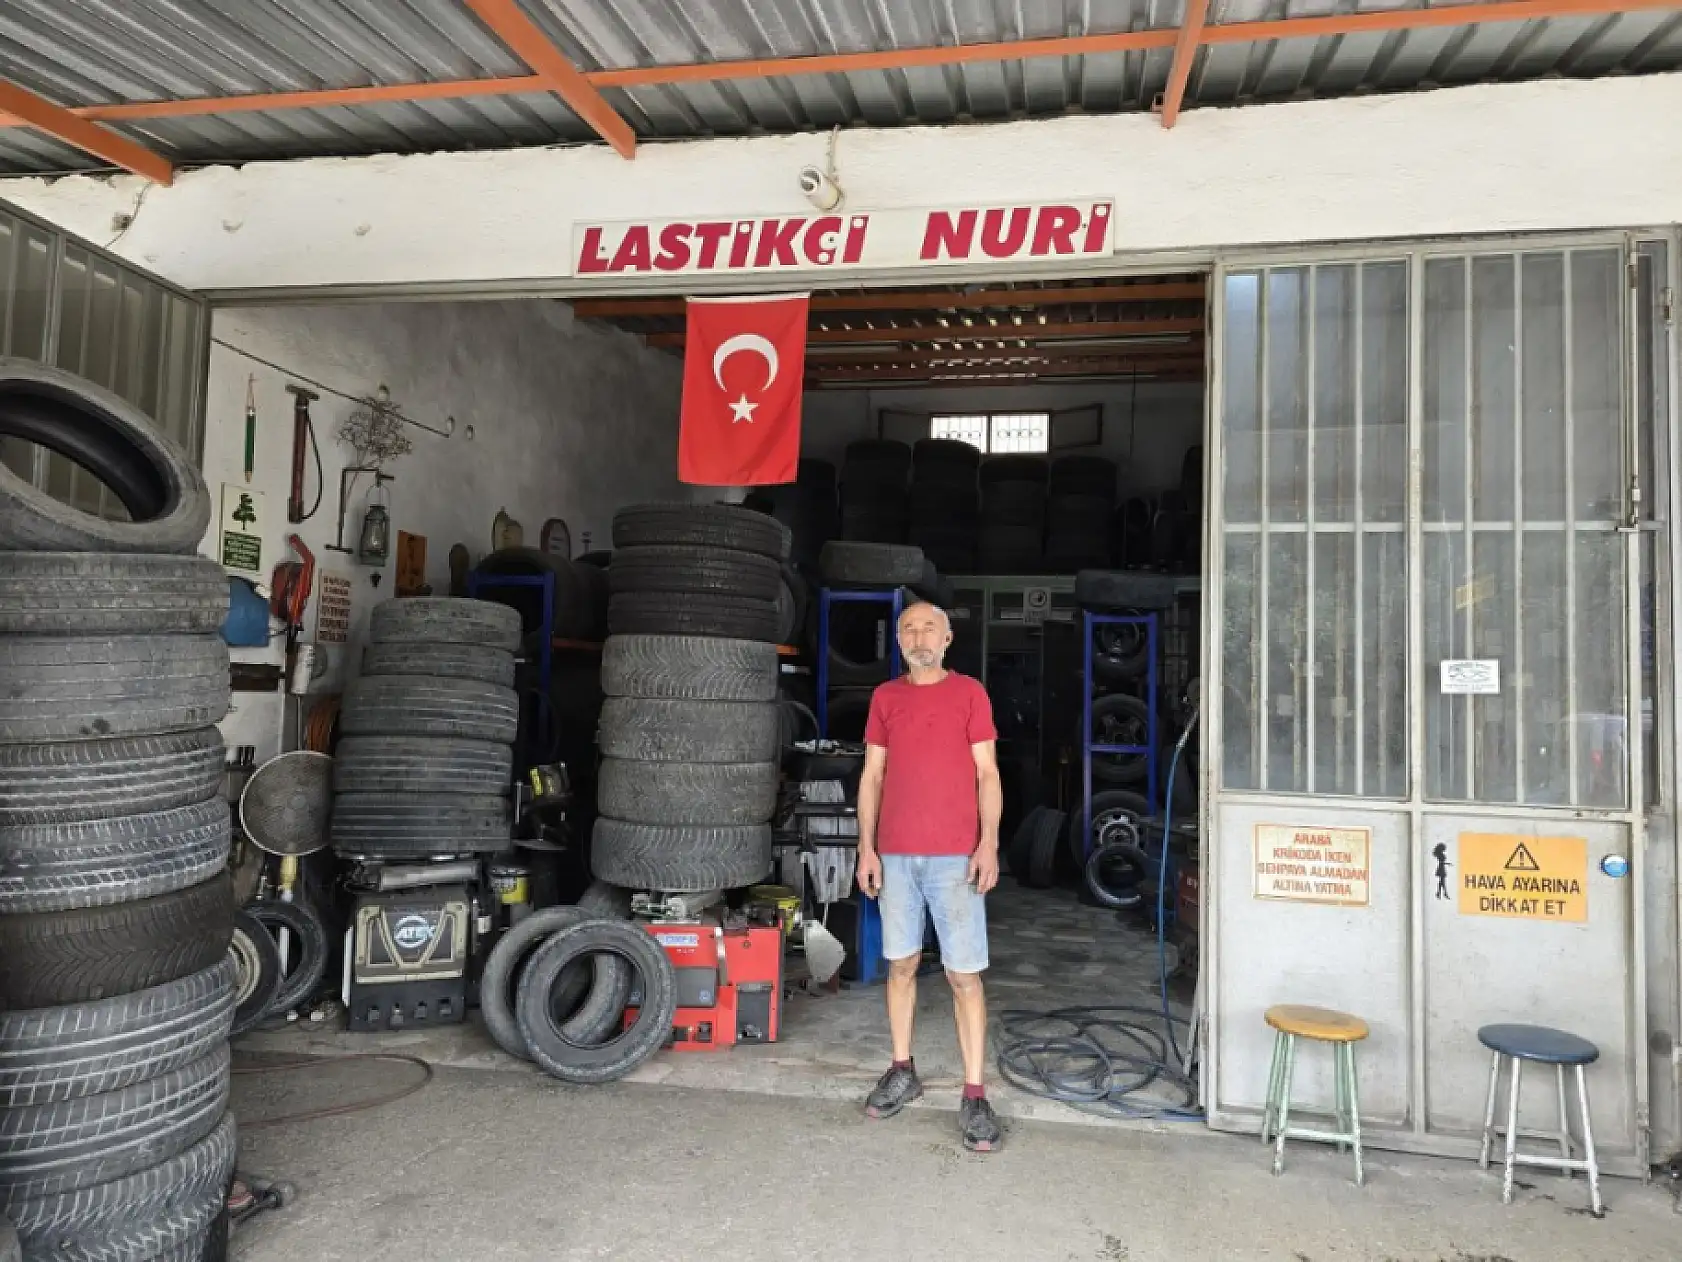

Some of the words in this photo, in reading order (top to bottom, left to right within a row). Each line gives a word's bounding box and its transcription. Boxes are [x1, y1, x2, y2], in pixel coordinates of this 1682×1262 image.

[1294, 832, 1332, 846] ARABA
[1309, 866, 1367, 880] ALMADAN
[1314, 881, 1351, 895] YATMA
[1464, 873, 1506, 890] HAVA
[1512, 876, 1580, 894] AYARINA
[1480, 893, 1539, 914] DİKKAT
[1544, 899, 1566, 915] ET
